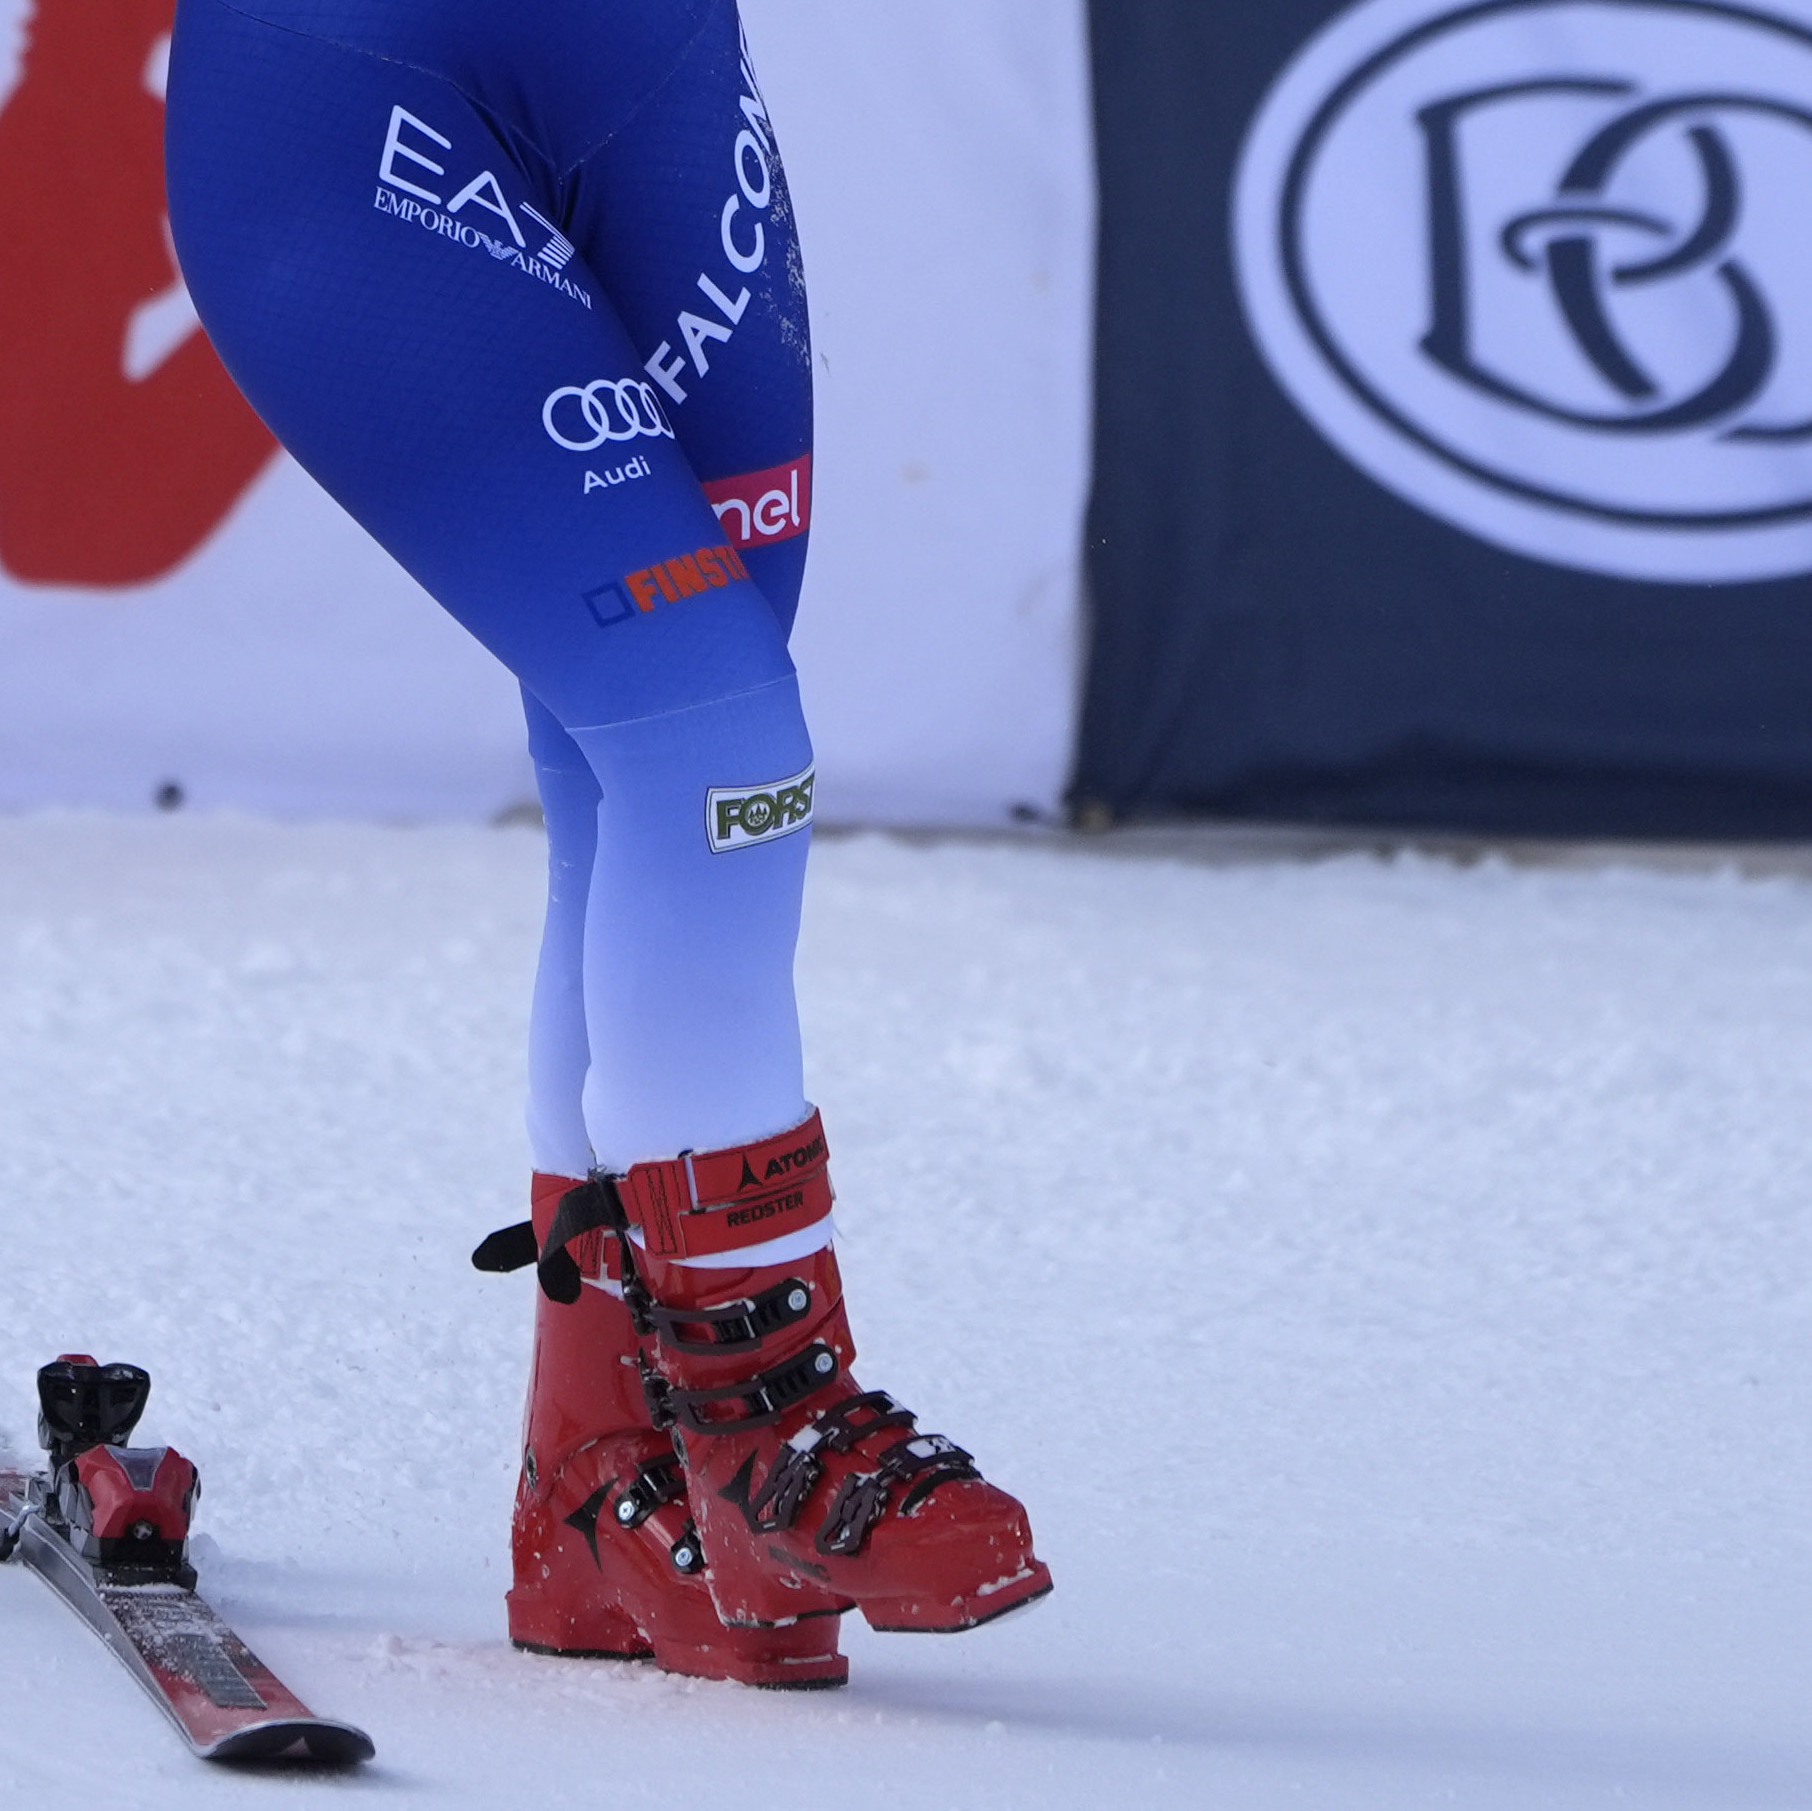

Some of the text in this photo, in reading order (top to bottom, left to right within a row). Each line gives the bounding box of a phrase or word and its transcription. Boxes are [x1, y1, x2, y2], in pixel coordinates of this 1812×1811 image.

[378, 104, 576, 271] EA7
[373, 186, 592, 311] EMPORIO ARMANI
[583, 455, 652, 494] Audi
[710, 468, 801, 541] nel
[726, 1190, 804, 1228] REDSTER
